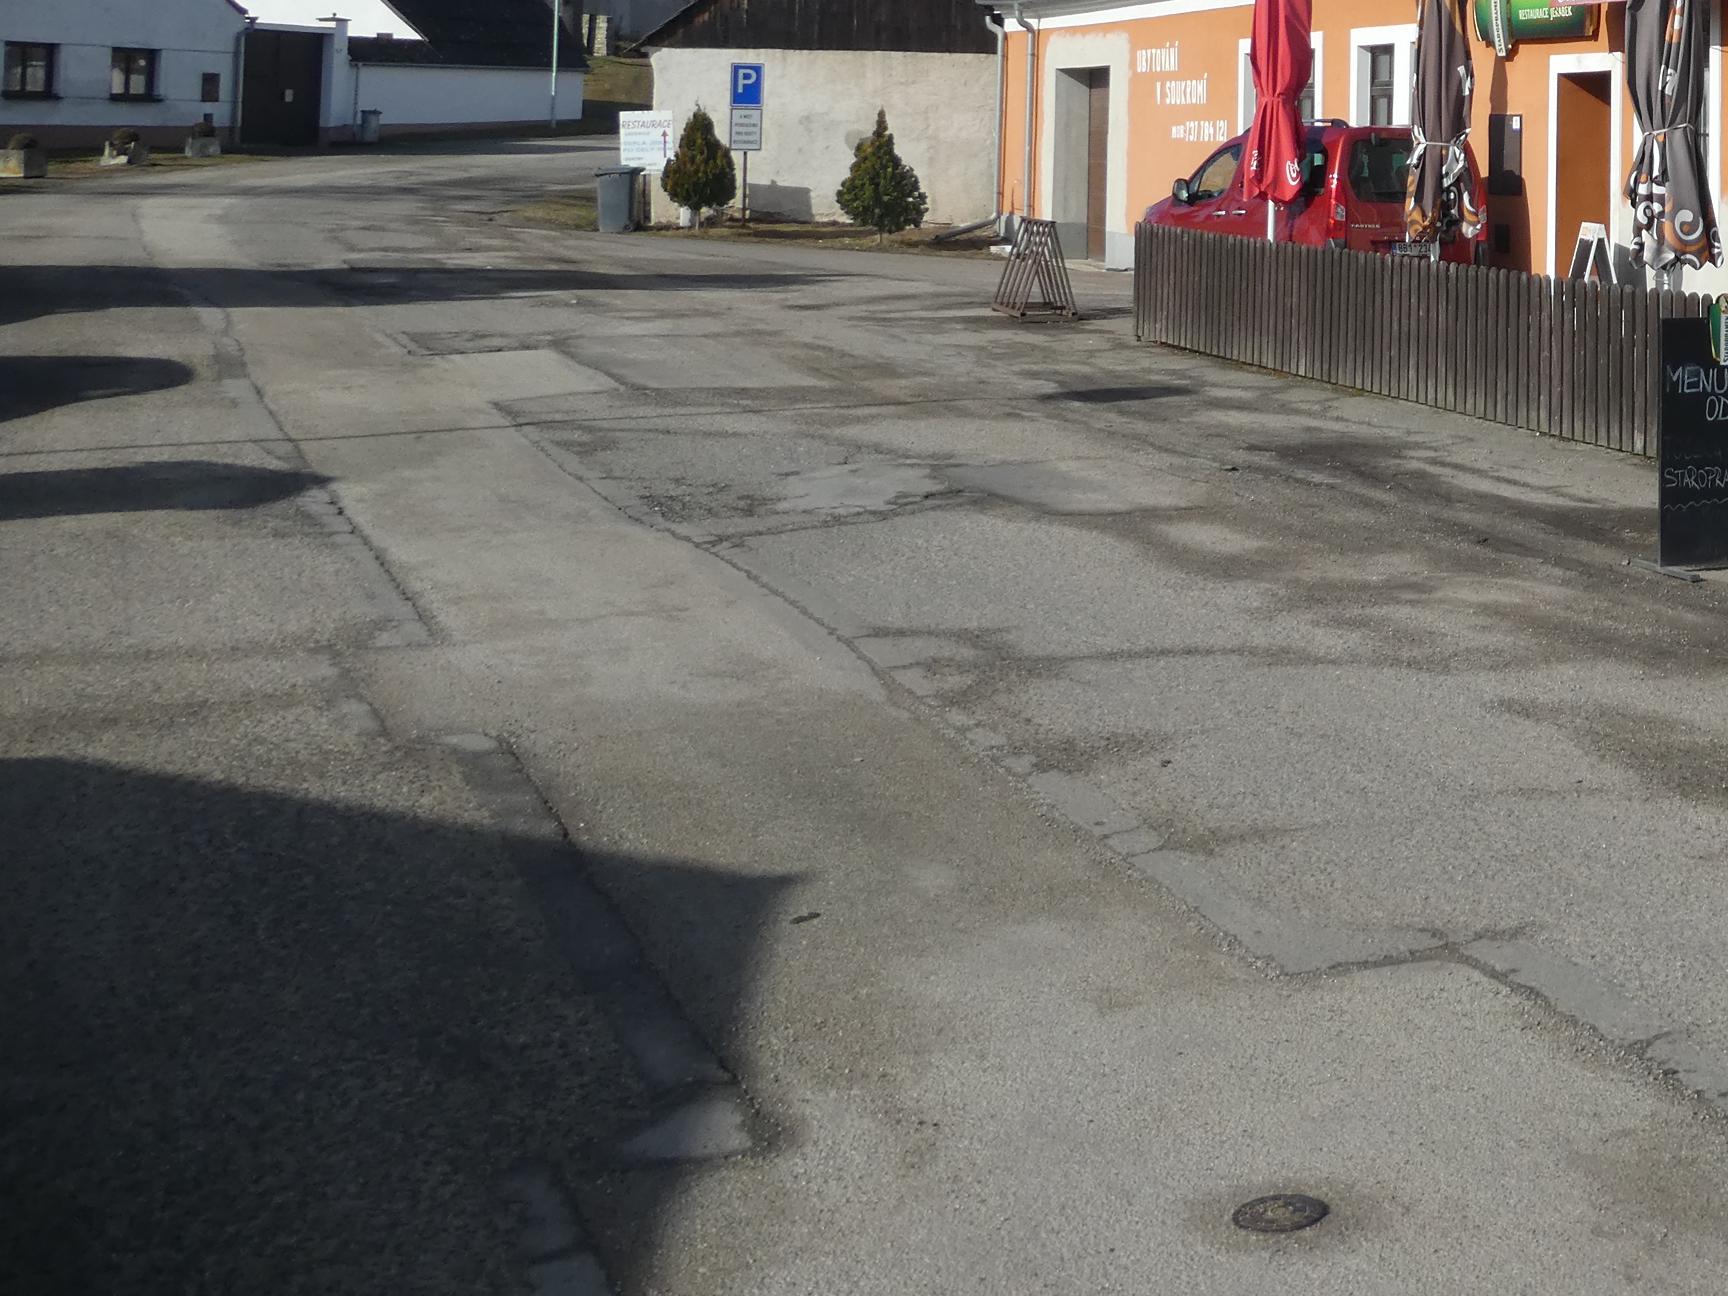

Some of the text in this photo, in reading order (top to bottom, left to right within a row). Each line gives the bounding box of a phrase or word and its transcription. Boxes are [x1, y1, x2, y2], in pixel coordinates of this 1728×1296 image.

[1518, 8, 1549, 20] RESTAURACE
[1136, 40, 1179, 73] UBYTOVÁNÍ
[737, 68, 757, 93] P
[1156, 72, 1208, 105] V SOUKROMÍ
[621, 119, 673, 130] RESTAURACE
[1216, 119, 1228, 142] 121
[1666, 365, 1728, 394] MENU
